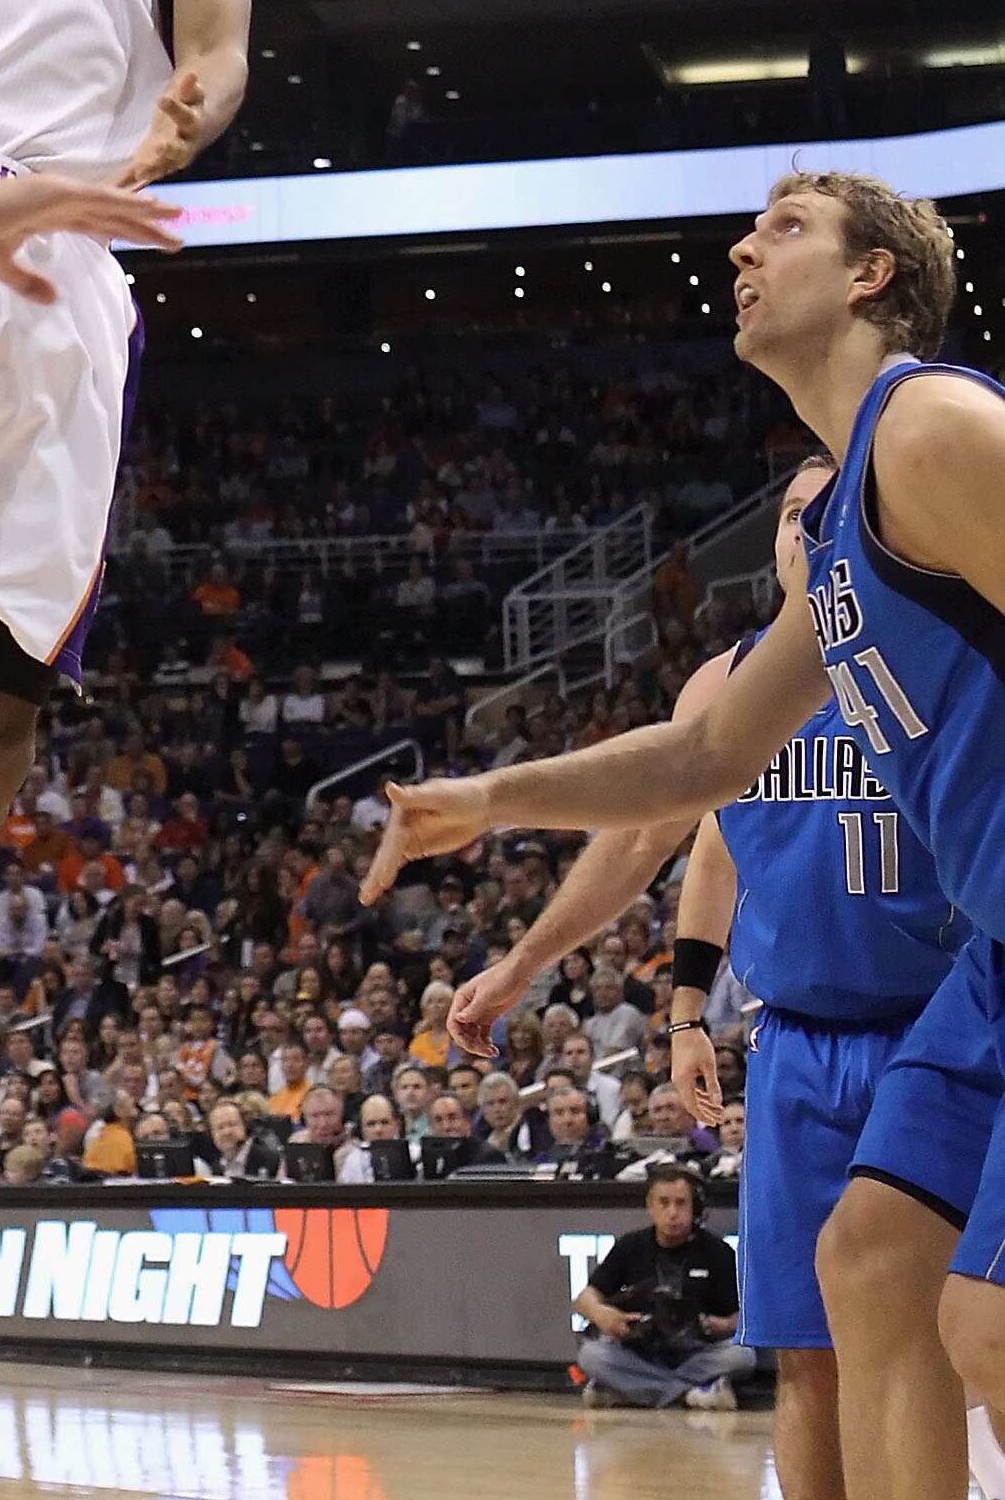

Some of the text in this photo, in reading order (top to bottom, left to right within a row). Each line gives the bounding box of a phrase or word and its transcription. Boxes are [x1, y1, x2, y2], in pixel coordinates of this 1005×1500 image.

[826, 646, 929, 755] 41
[837, 812, 899, 895] 11
[22, 1220, 288, 1328] NIGHT
